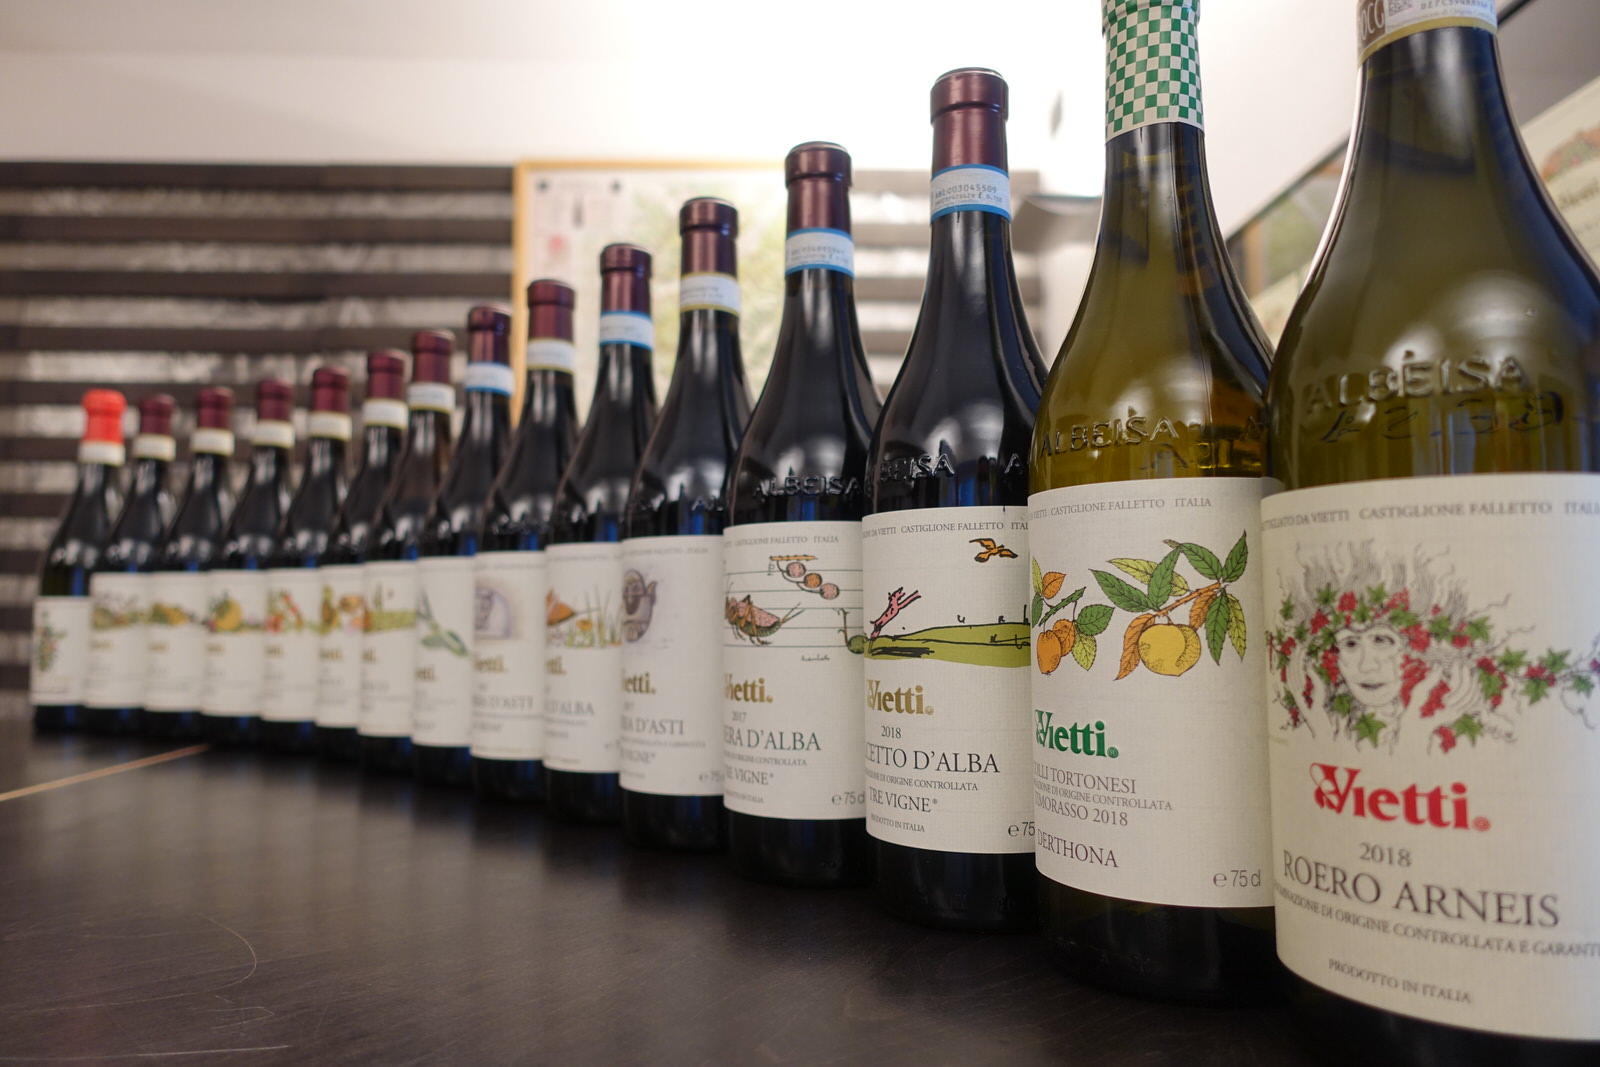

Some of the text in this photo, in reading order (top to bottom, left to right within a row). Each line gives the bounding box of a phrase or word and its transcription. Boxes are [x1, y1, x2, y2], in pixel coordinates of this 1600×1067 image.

[1050, 501, 1106, 517] CASTIGLIONE
[1108, 498, 1165, 512] FALLETTO
[1174, 497, 1212, 508] ITALIA
[1359, 502, 1465, 520] CASTIGLIONE
[1469, 502, 1552, 517] FALLETTO
[813, 534, 840, 544] ITALIA
[900, 522, 956, 534] CASTIGLIONE
[957, 521, 1004, 532] FALLETTO
[747, 728, 821, 751] D'ALBA
[881, 725, 902, 739] 2018
[1034, 709, 1107, 758] Vietti
[913, 750, 1000, 774] D'ALBA
[735, 767, 769, 786] VIGNE
[886, 774, 913, 788] ORIGINE
[914, 779, 979, 792] CONTROLLATA
[1050, 767, 1137, 795] TORTONESI
[885, 791, 931, 813] VIGNE
[1058, 787, 1092, 804] ORIGINE
[1092, 794, 1173, 812] CONTROLLATA
[1309, 762, 1470, 831] Vietti
[902, 822, 925, 833] ITALIA
[1092, 807, 1129, 827] 2018
[1036, 828, 1120, 869] DERTHONA
[1359, 842, 1413, 868] 2018
[1283, 849, 1561, 930] ROERO ARNEIS
[1321, 905, 1333, 919] DI
[1334, 908, 1391, 935] ORIGINE
[1392, 921, 1516, 954] CONTROLLATA
[1328, 957, 1472, 1005] PRODOTTO IN ITALIA
